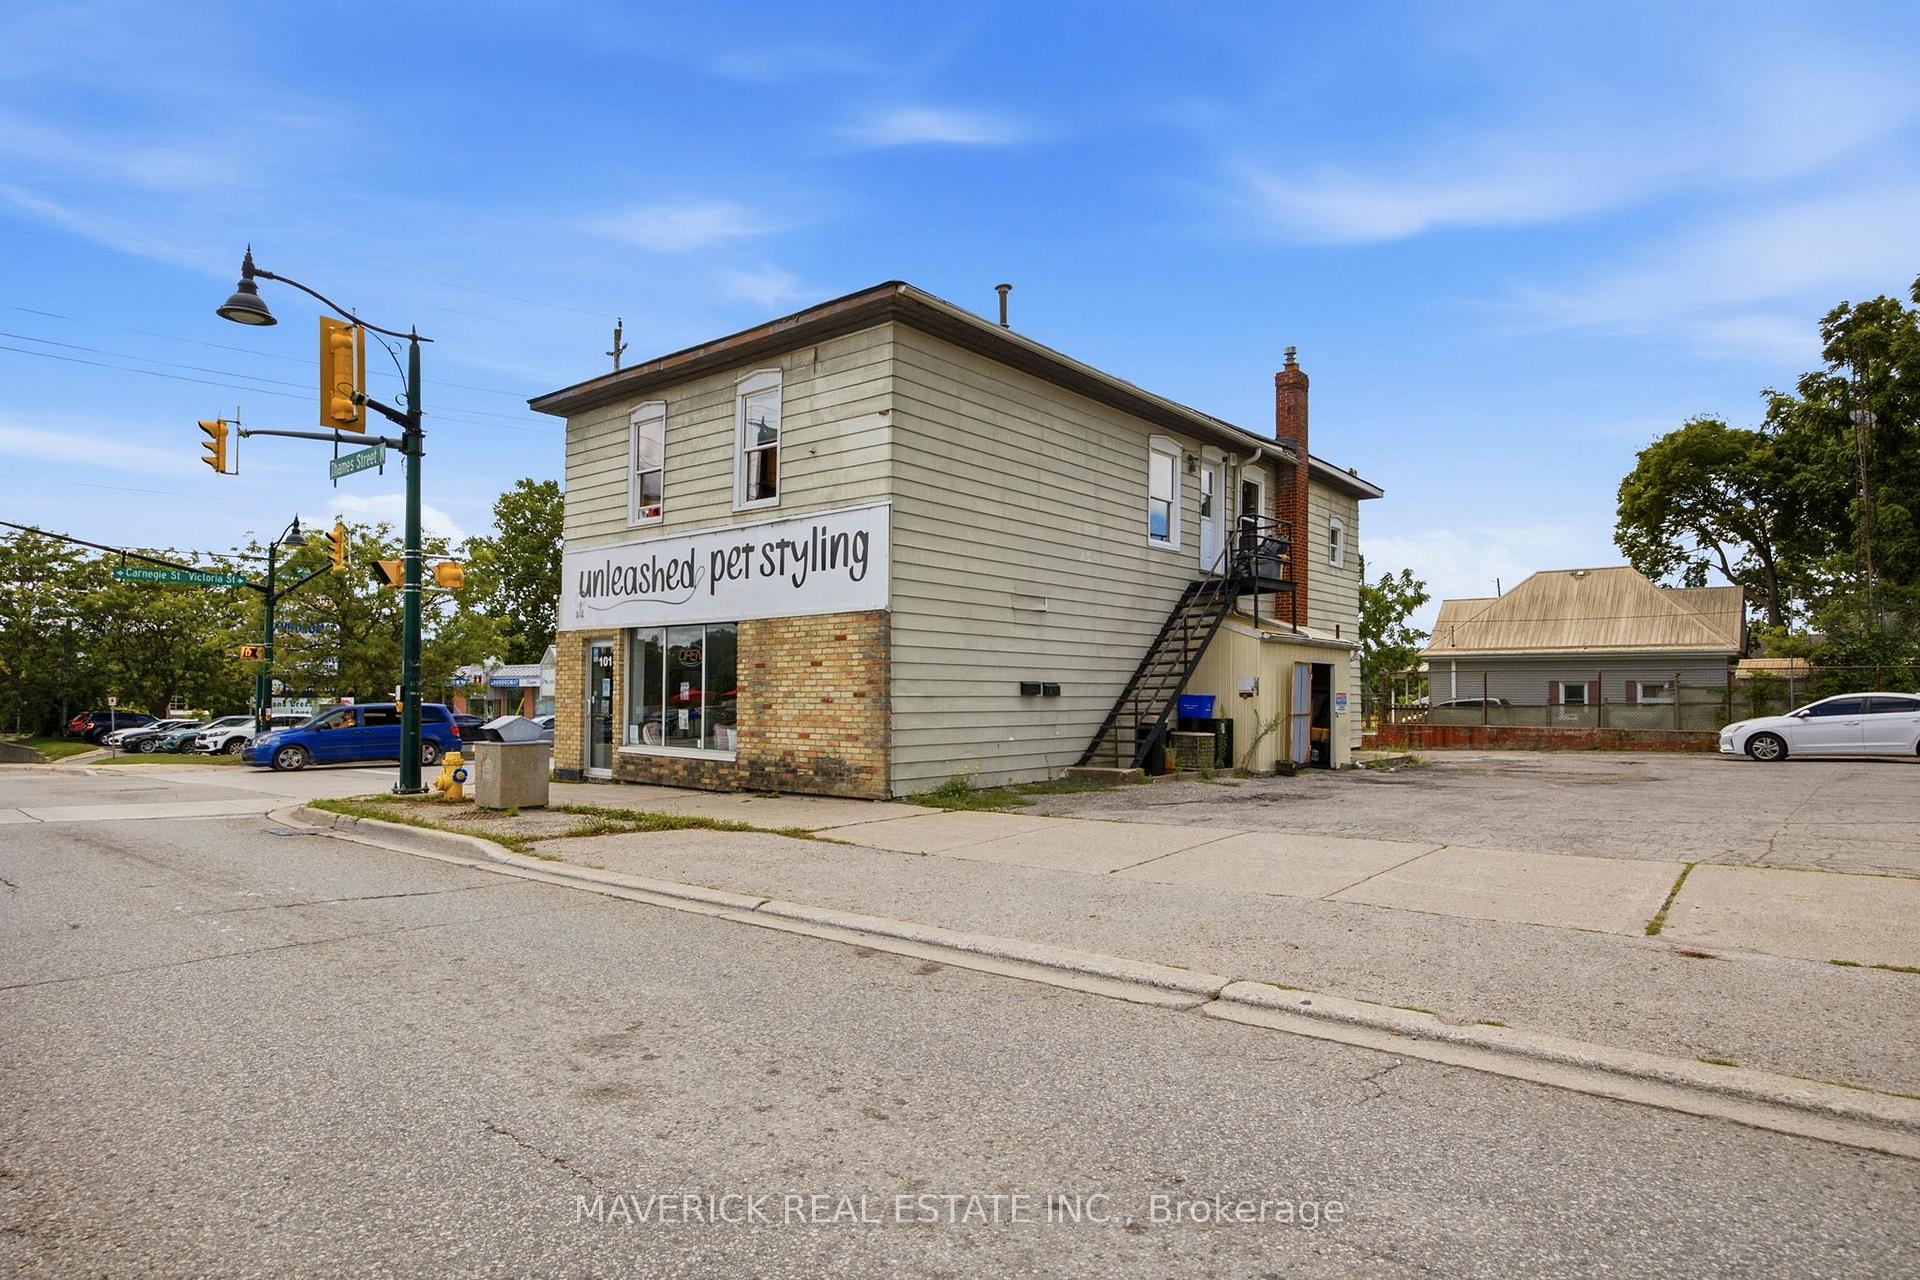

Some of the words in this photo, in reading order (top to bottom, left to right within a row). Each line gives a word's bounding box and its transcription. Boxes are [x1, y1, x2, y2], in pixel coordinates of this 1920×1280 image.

[331, 459, 355, 478] Thames
[356, 449, 378, 469] Street
[379, 445, 385, 462] N
[579, 547, 696, 599] unleashed
[710, 542, 755, 596] pet
[759, 526, 870, 589] styling
[125, 568, 167, 581] Carnegie
[170, 572, 181, 580] St
[188, 572, 223, 583] Victoria
[225, 575, 236, 584] St
[599, 655, 612, 667] 101
